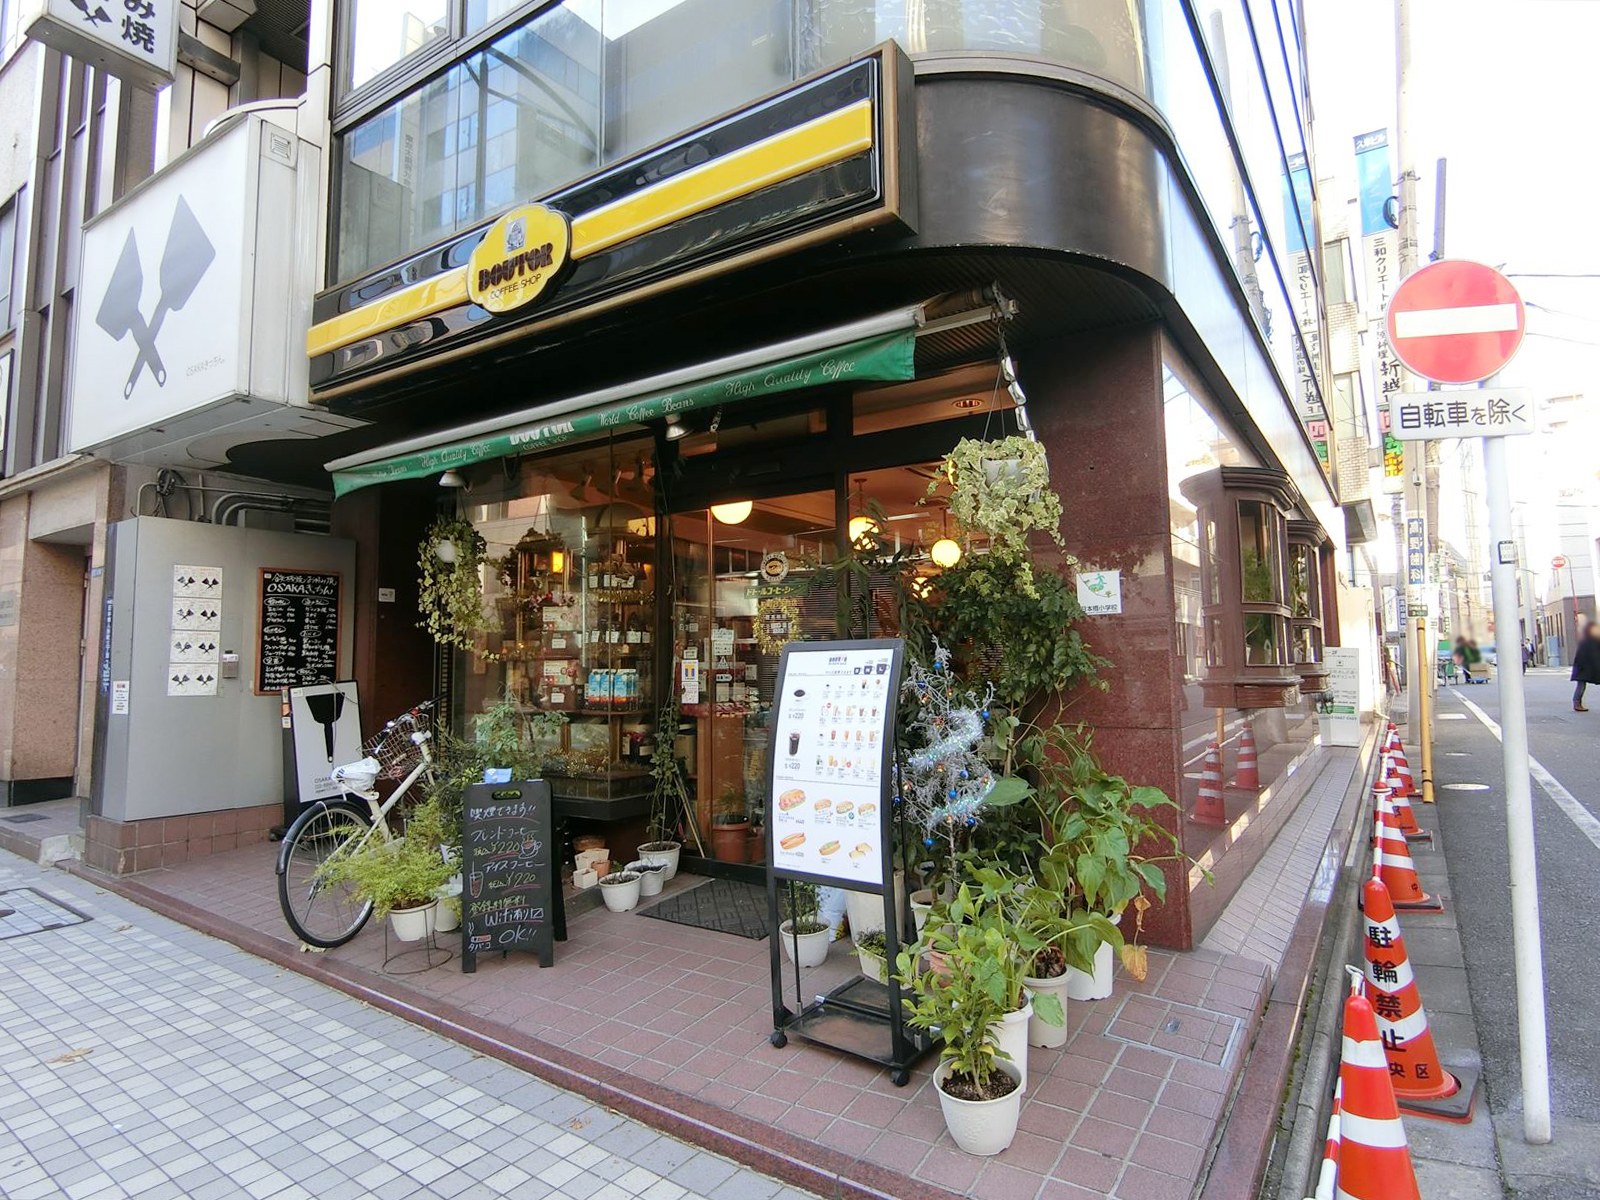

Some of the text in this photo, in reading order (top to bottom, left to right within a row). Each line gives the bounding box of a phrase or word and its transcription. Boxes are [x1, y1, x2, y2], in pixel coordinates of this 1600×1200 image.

[478, 243, 553, 292] DOUTOR
[490, 273, 542, 300] COFFEE SHOP
[725, 359, 855, 397] High Quality Coffee
[598, 396, 695, 427] World Coffee Beans
[1400, 397, 1527, 430] 自転車を除く
[482, 860, 545, 873] アイスコーヒー
[467, 942, 491, 952] タバコ
[1368, 926, 1407, 1053] 駐輪禁止
[1389, 1062, 1430, 1079] 央区
